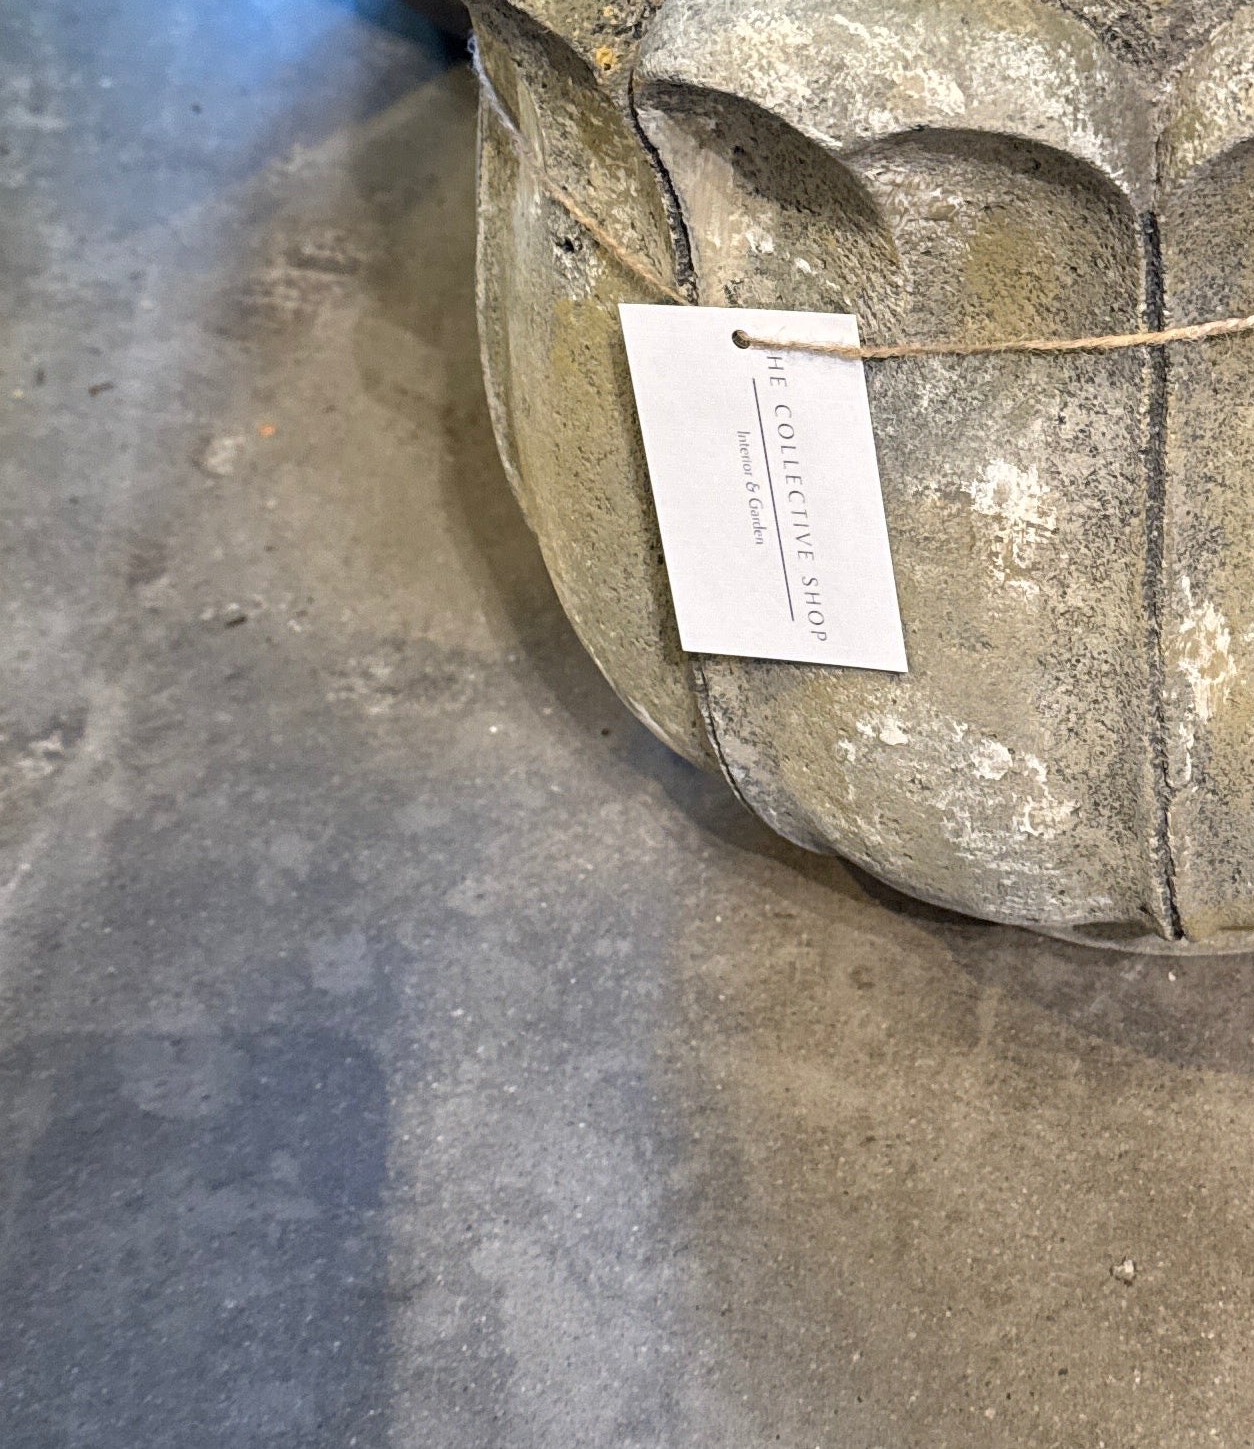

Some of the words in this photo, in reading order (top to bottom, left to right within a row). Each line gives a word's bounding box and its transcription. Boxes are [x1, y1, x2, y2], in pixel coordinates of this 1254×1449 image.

[765, 351, 789, 388] HE
[736, 430, 753, 477] Interior
[746, 480, 757, 493] &
[774, 403, 816, 562] COLLECTIVE
[748, 498, 764, 546] Garden
[801, 576, 828, 642] SHOP
